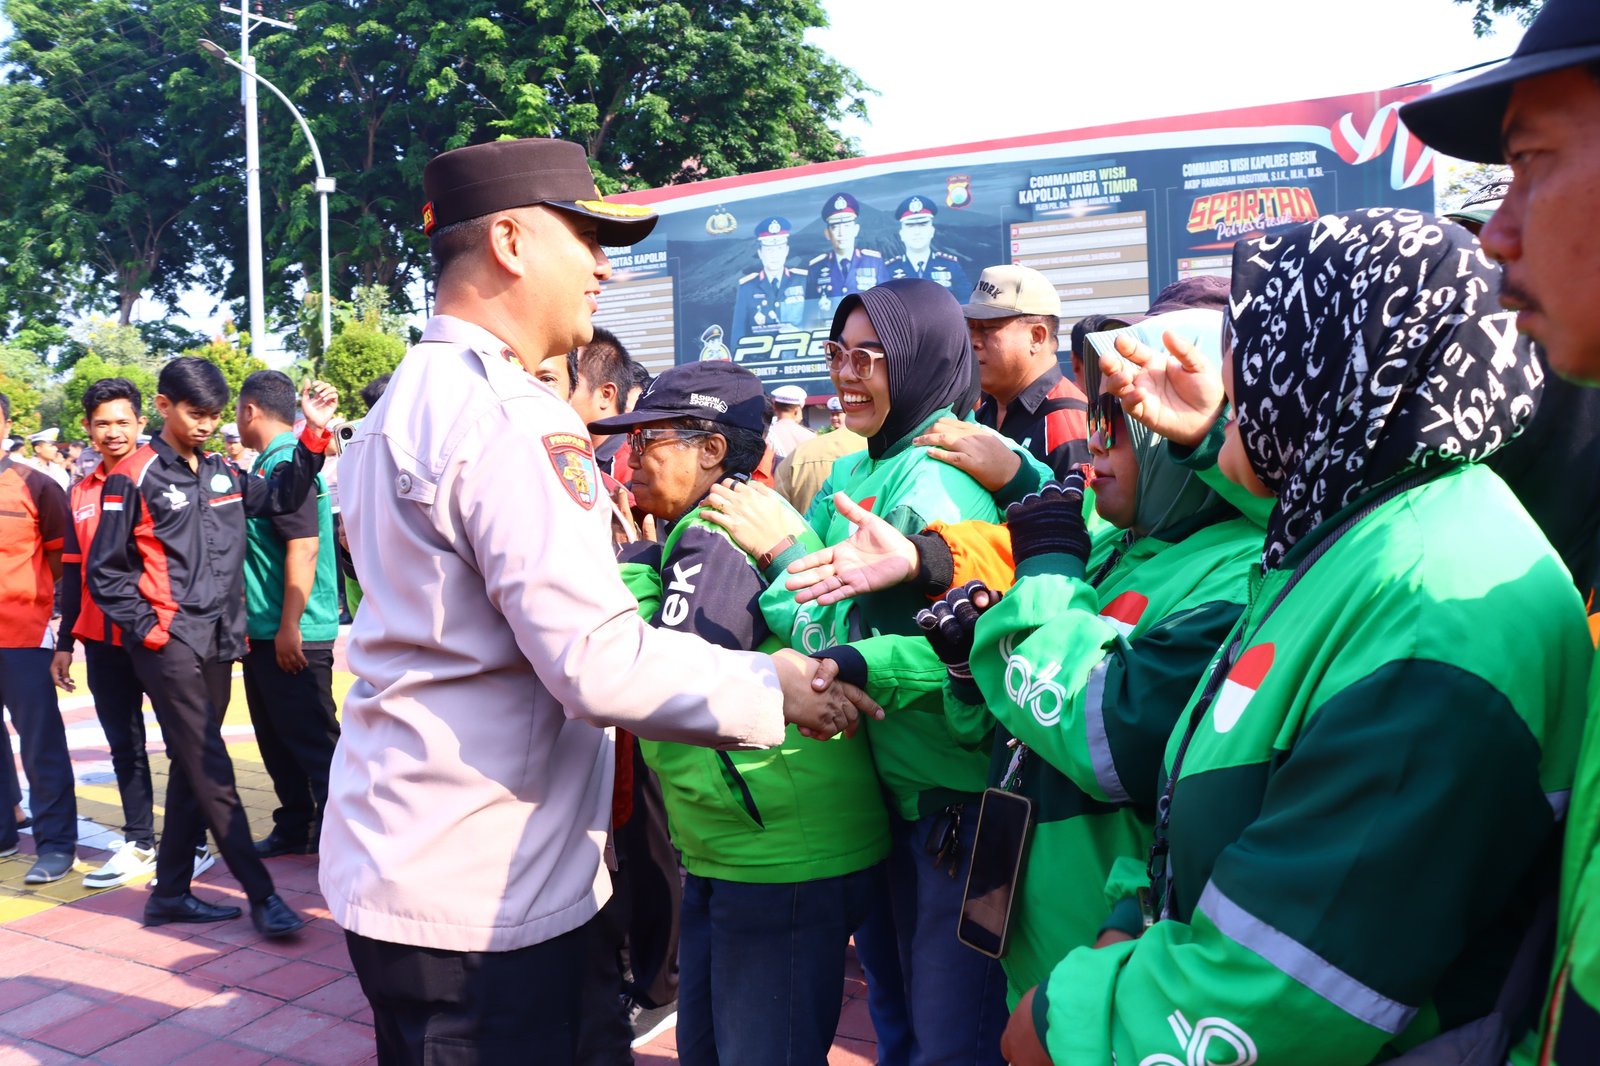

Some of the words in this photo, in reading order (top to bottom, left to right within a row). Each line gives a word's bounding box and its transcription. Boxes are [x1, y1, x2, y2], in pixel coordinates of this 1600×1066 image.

[1182, 159, 1230, 177] COMMANDER
[1230, 157, 1250, 172] WISH
[1250, 153, 1289, 170] KAPOLRES
[1290, 150, 1317, 166] GRESIK
[1029, 169, 1097, 188] COMMANDER
[1098, 166, 1126, 180] WISH
[1018, 186, 1067, 204] KAPOLDA
[1069, 182, 1100, 199] JAWA
[1101, 178, 1138, 195] TIMUR
[1187, 187, 1320, 234] SPARTAN
[1214, 220, 1255, 241] Polres
[633, 251, 667, 265] KAPOLRI
[548, 435, 587, 450] PROPAM
